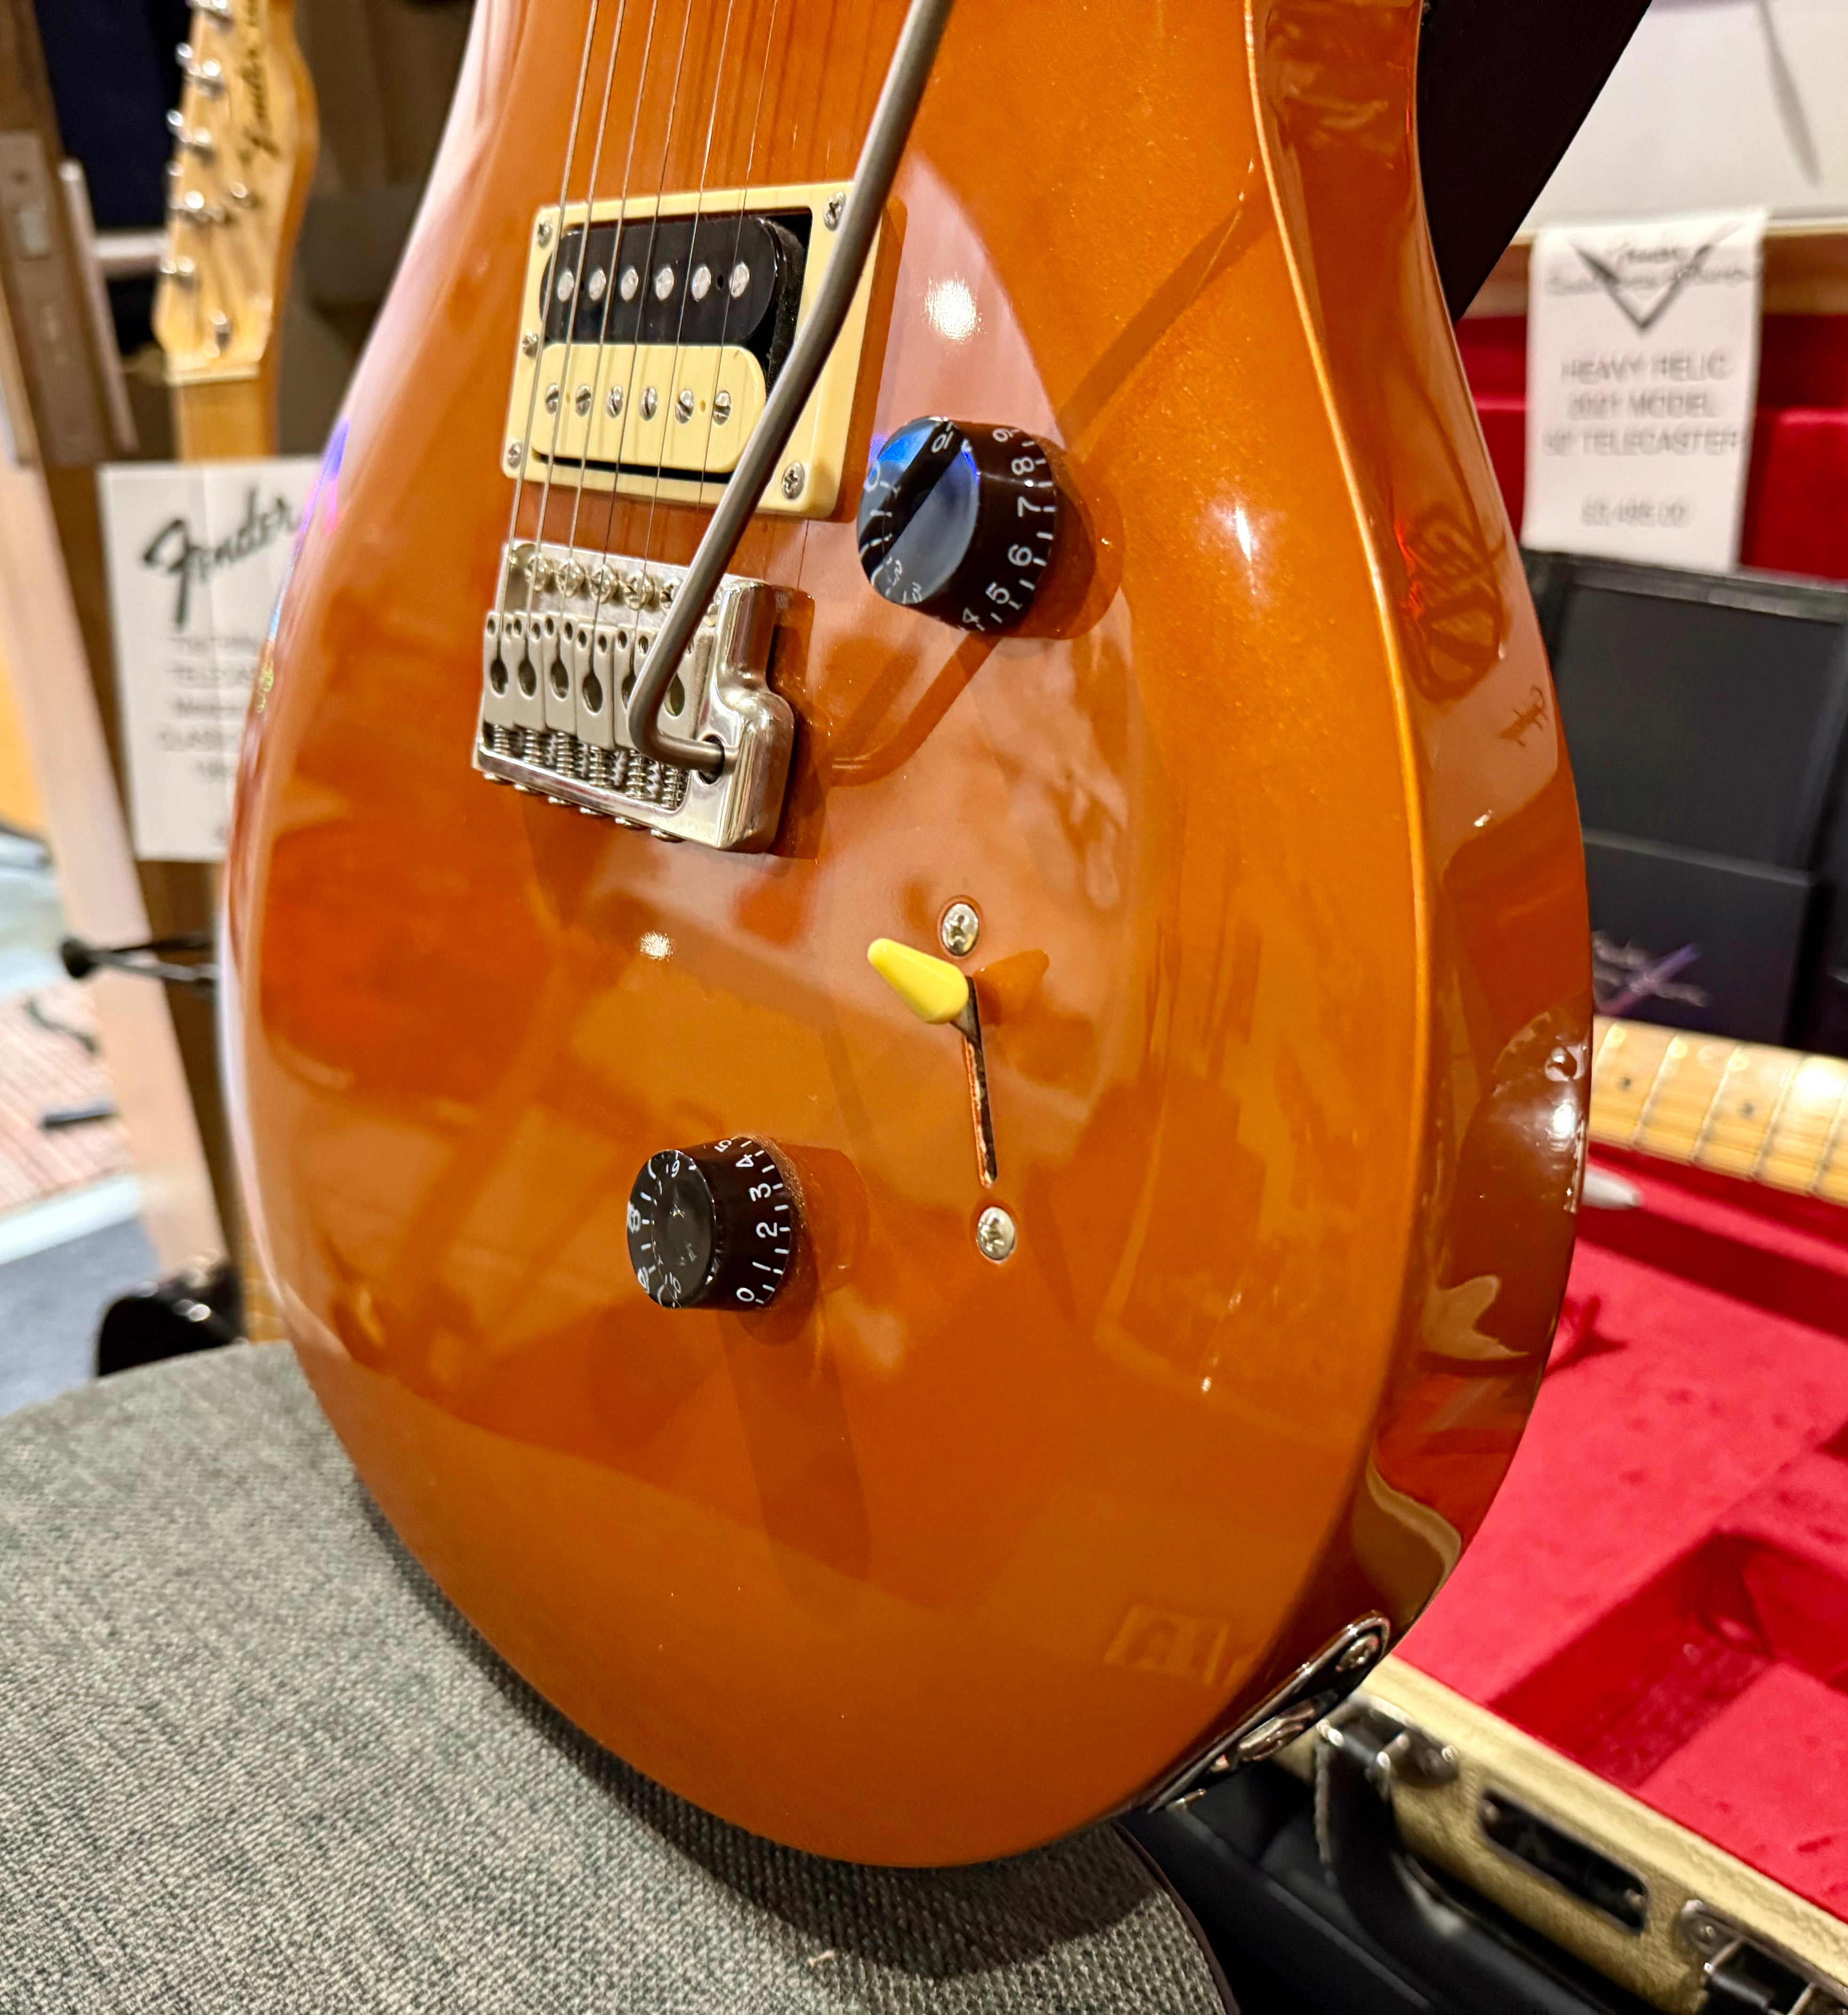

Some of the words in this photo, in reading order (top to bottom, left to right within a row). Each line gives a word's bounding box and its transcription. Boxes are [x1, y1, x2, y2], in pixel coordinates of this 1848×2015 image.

[1011, 456, 1034, 475] 8
[1018, 497, 1041, 517] 7
[133, 487, 299, 633] Fender
[986, 582, 1010, 604] 5
[963, 608, 979, 623] 4
[714, 1140, 732, 1152] 5
[735, 1154, 754, 1168] 4
[749, 1183, 771, 1201] 3
[756, 1222, 778, 1238] 2
[736, 1287, 755, 1302] 0
